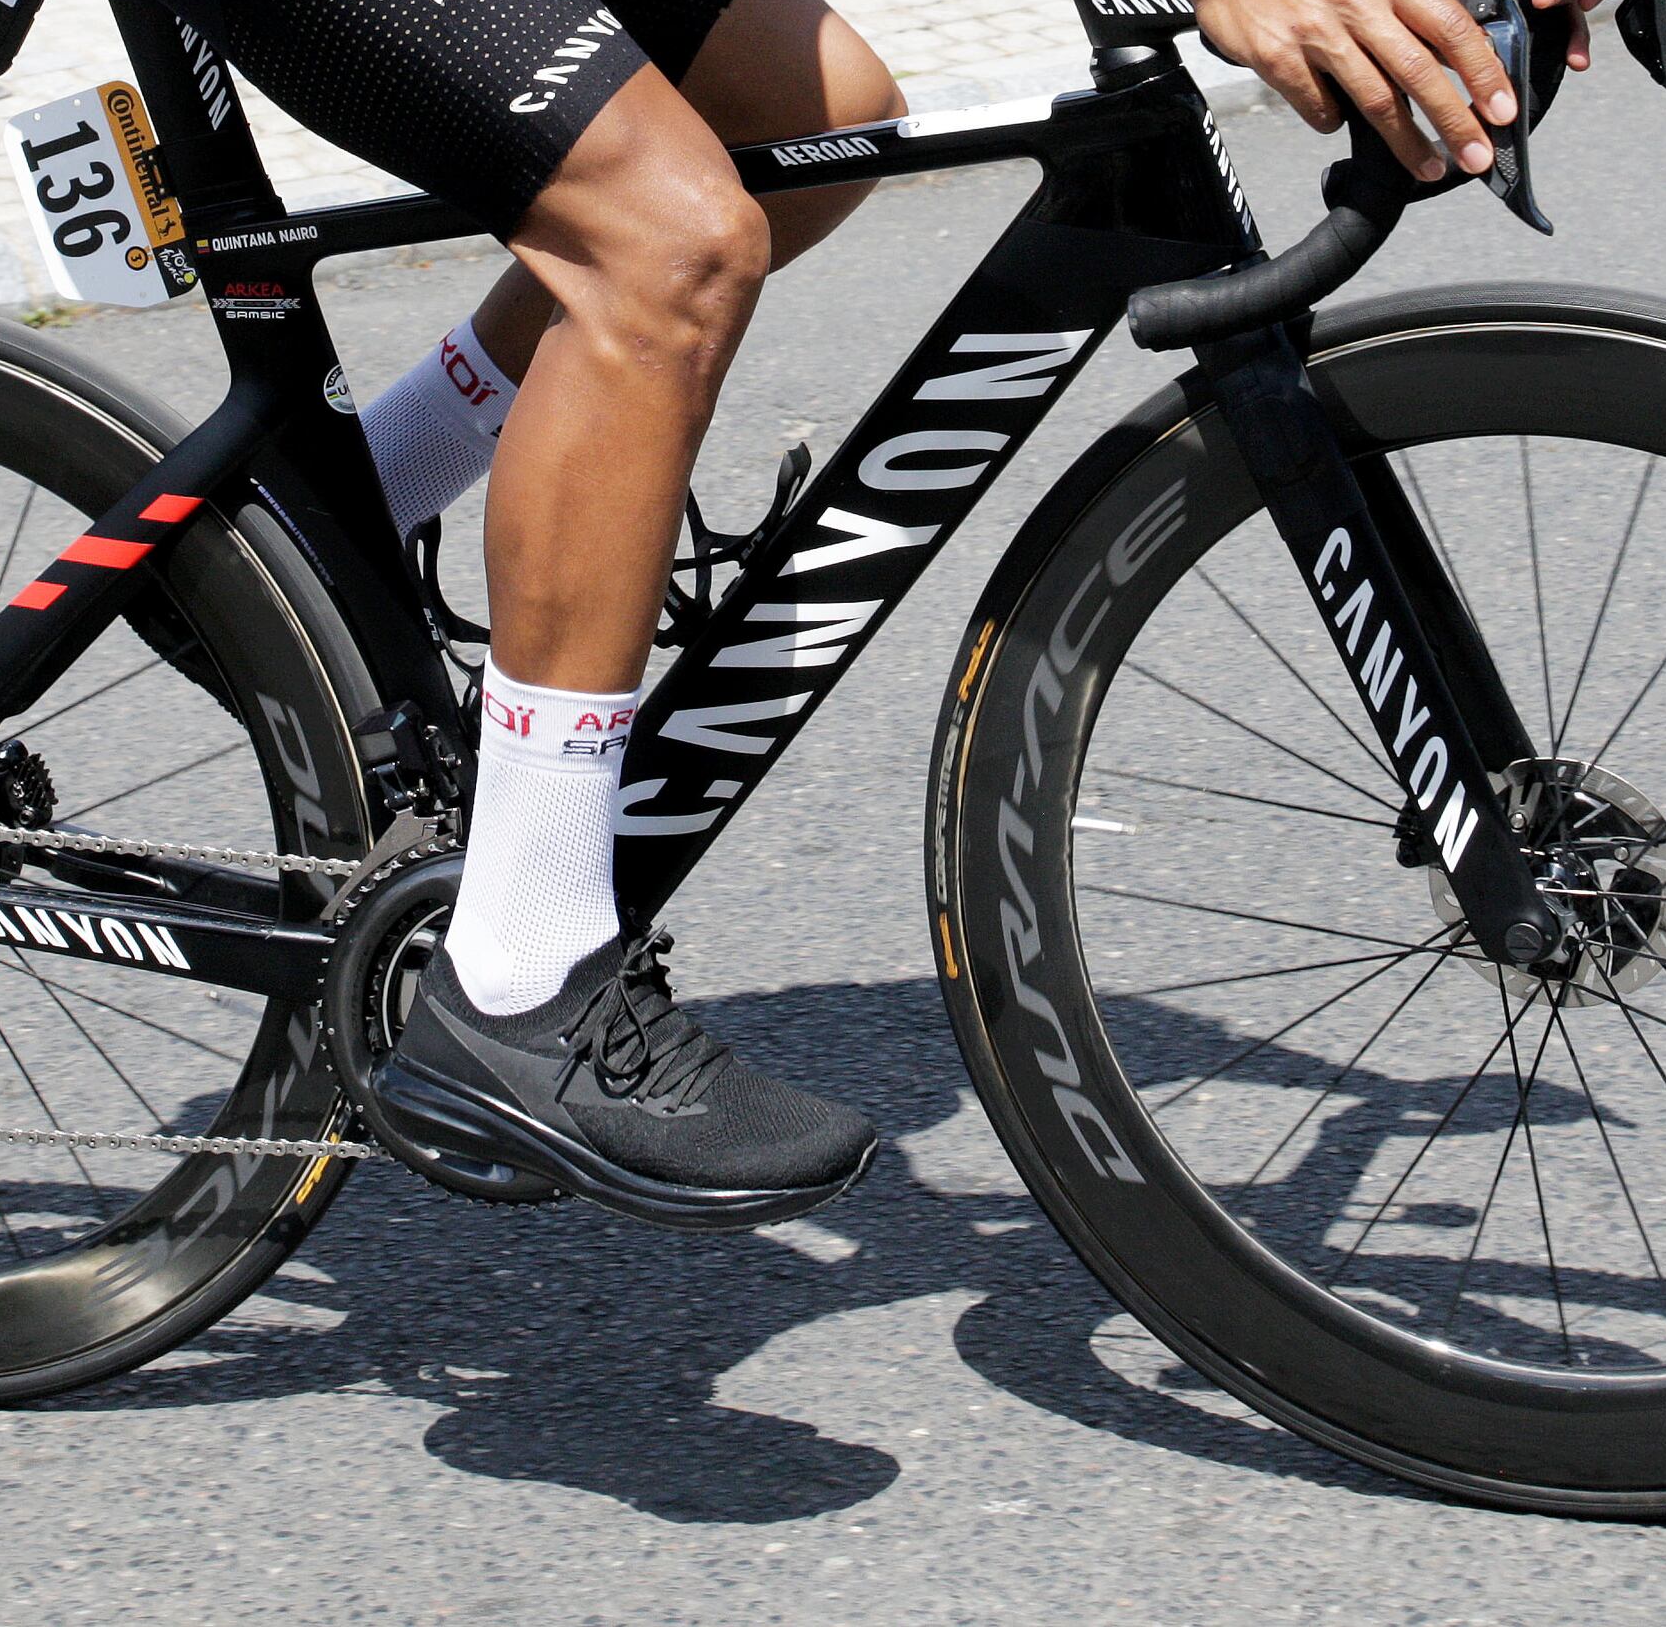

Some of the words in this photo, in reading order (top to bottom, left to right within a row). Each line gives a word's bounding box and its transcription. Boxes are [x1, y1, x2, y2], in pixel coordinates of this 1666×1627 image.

[175, 15, 232, 132] NYON
[21, 119, 132, 259] 136
[771, 136, 881, 168] AEROAD
[1202, 109, 1253, 235] CANYON
[212, 231, 276, 252] QUINTANA
[279, 225, 319, 243] NAIRO
[224, 282, 285, 298] ARKEA
[225, 310, 286, 320] SAMSIC
[616, 327, 1095, 836] CANYON
[1312, 527, 1480, 872] CANYON
[997, 476, 1188, 1186] DURA-ACE
